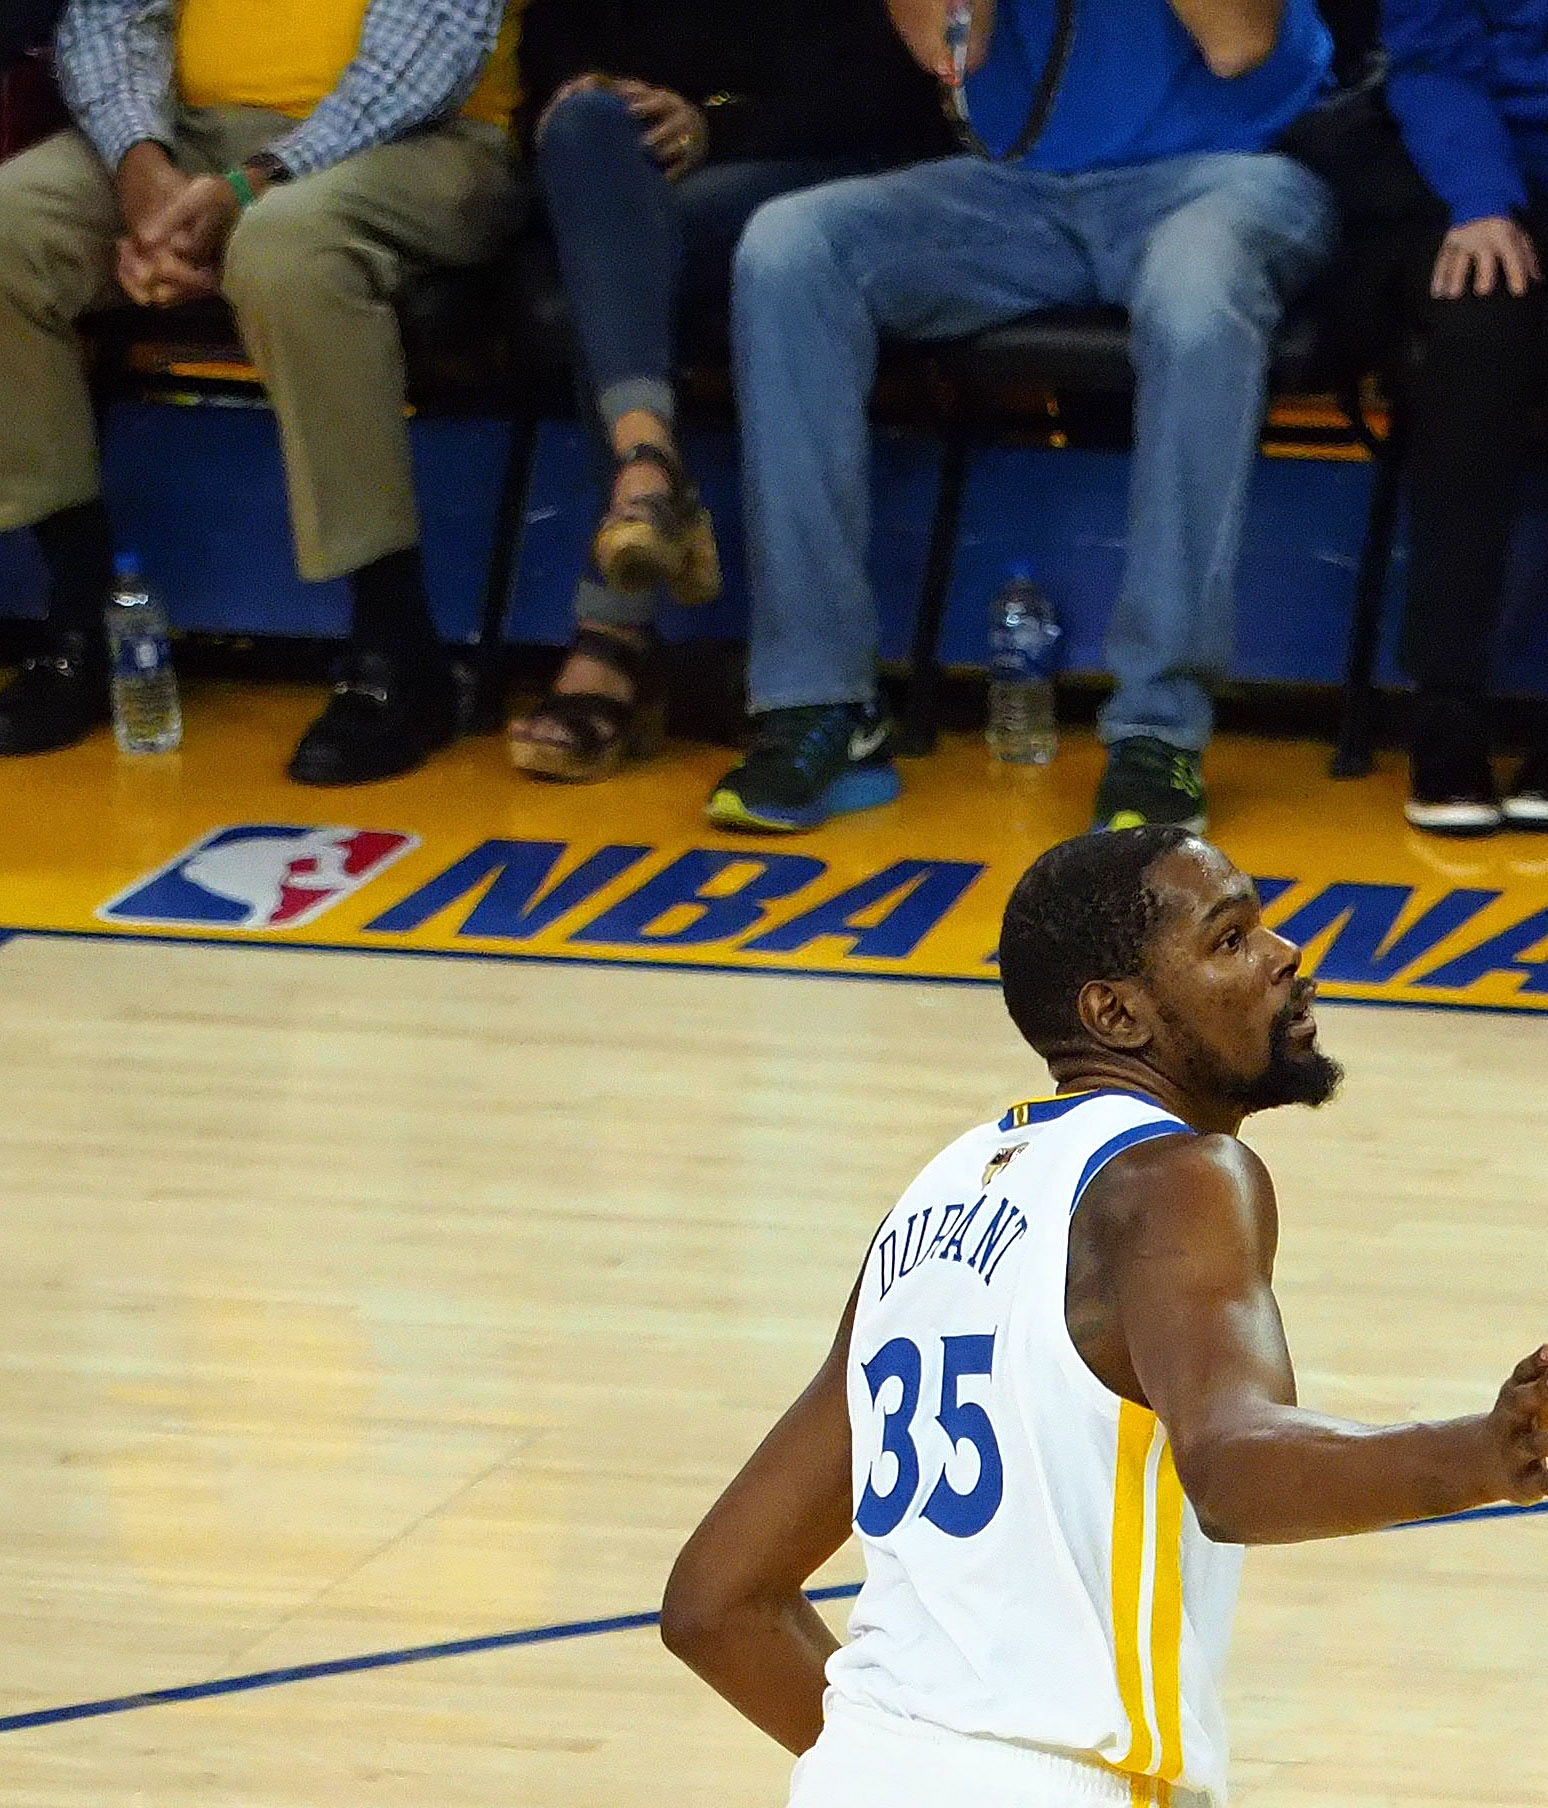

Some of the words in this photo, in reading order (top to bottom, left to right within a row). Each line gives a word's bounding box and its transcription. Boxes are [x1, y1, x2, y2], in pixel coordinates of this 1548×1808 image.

[365, 838, 987, 958] NBA
[879, 1194, 1028, 1302] DURANT
[853, 1324, 1004, 1538] 35
